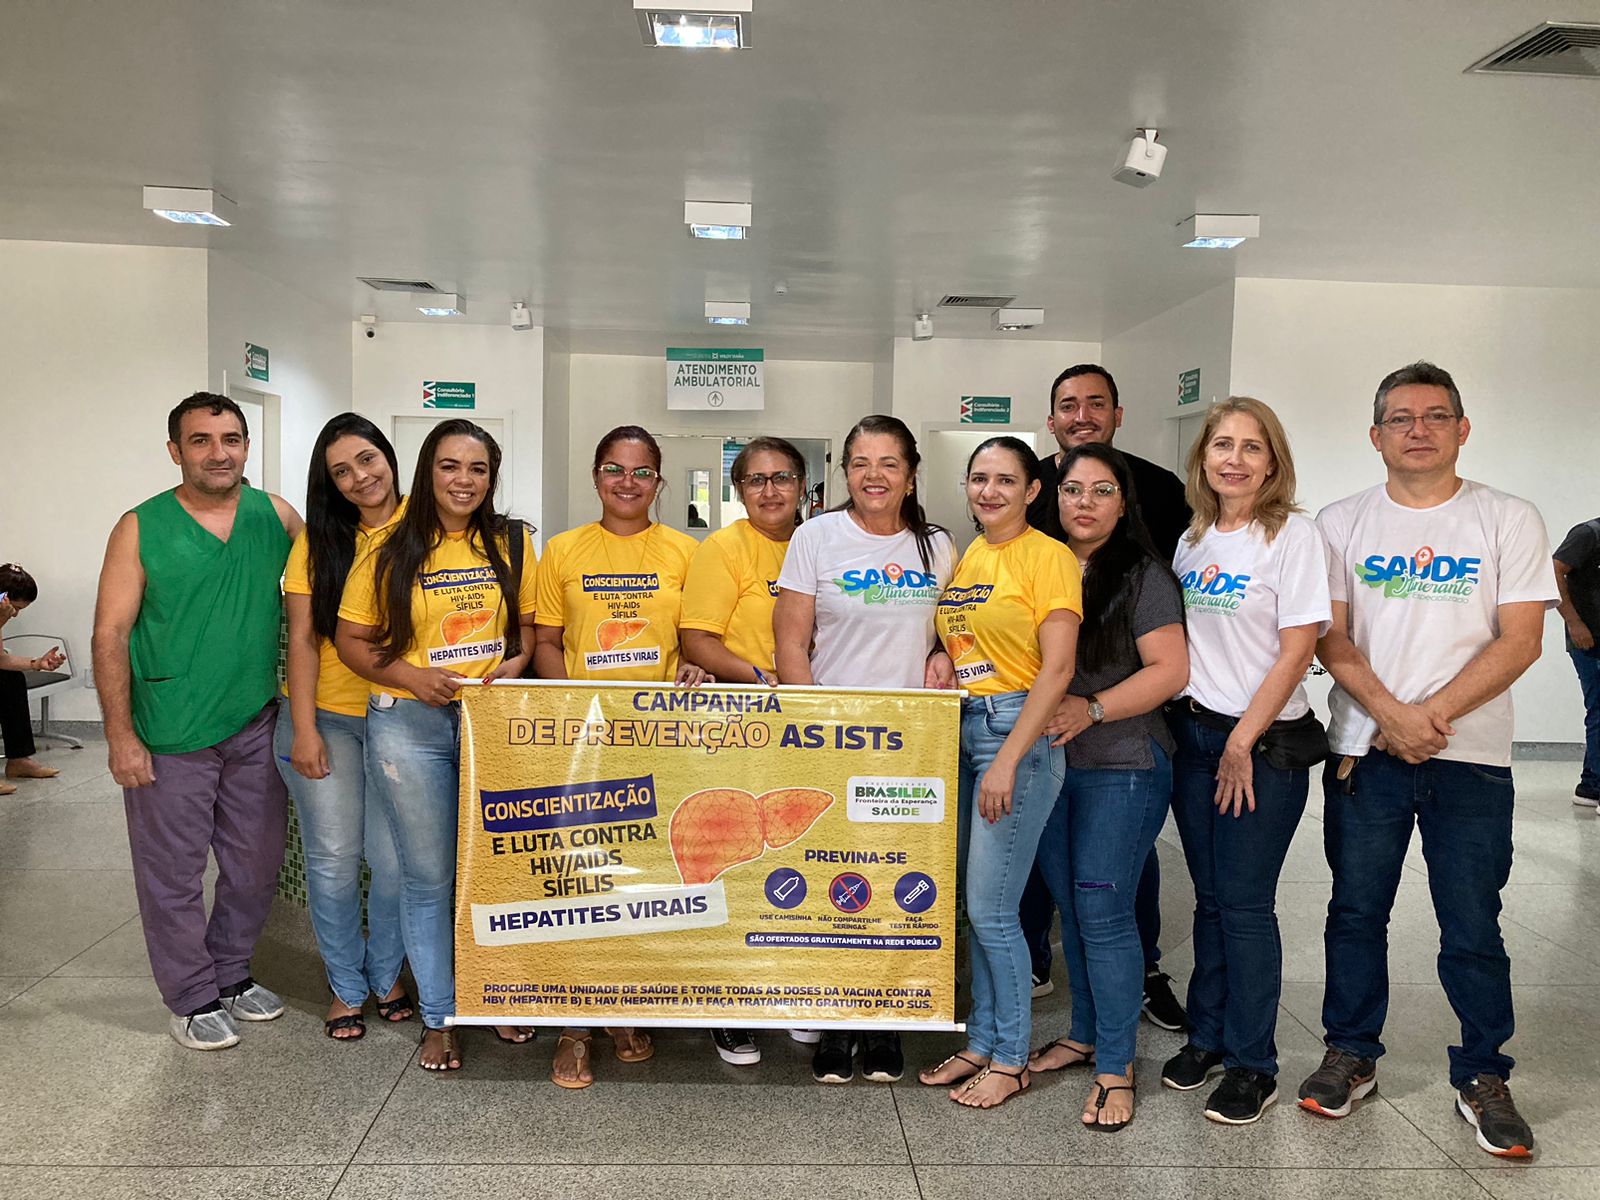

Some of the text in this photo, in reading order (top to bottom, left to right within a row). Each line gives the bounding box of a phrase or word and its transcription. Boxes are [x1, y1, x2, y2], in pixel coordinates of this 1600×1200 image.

[677, 364, 757, 375] ATENDIMENTO
[674, 376, 760, 387] AMBULATORIAL
[441, 585, 463, 595] LUTA
[463, 583, 496, 593] CONTRA
[583, 575, 658, 589] CONSCIENTIZAÇÃO
[455, 601, 484, 612] SÍFILIS
[611, 609, 638, 619] SÍFILIS
[430, 646, 479, 662] HEPATITES
[586, 650, 659, 666] HEPATITES VIRAIS
[632, 691, 782, 714] CAMPANHA
[508, 713, 904, 754] DE PREVENÇÃO AS ISTs
[484, 784, 651, 822] CONSCIENTIZAÇÃO
[855, 797, 889, 805] Fronteira
[871, 805, 920, 816] SAÚDE
[492, 822, 657, 855] E LUTA CONTRA
[530, 849, 623, 877] HIV/AIDS
[804, 849, 908, 865] PREVINA-SE
[543, 870, 615, 897] SÍFILIS
[489, 895, 708, 932] HEPATITES VIRAIS
[833, 916, 882, 924] COMPARTILHE
[905, 916, 923, 924] FAÇA
[749, 935, 765, 943] SÃO
[765, 935, 810, 943] OFERTADOS
[810, 936, 872, 945] GRATUITAMENTE
[906, 938, 938, 946] PÚBLICA
[484, 982, 931, 997] PROCURE UMA UNIDADE DE SAÚDE E TOME TODAS AS DOSES DA VACINA CONTRA
[482, 995, 934, 1009] HBV (HEPATITE B) E HAV (HEPATITE A) E FAÇA TRATAMENTO GRATUITO PELO SUS.
